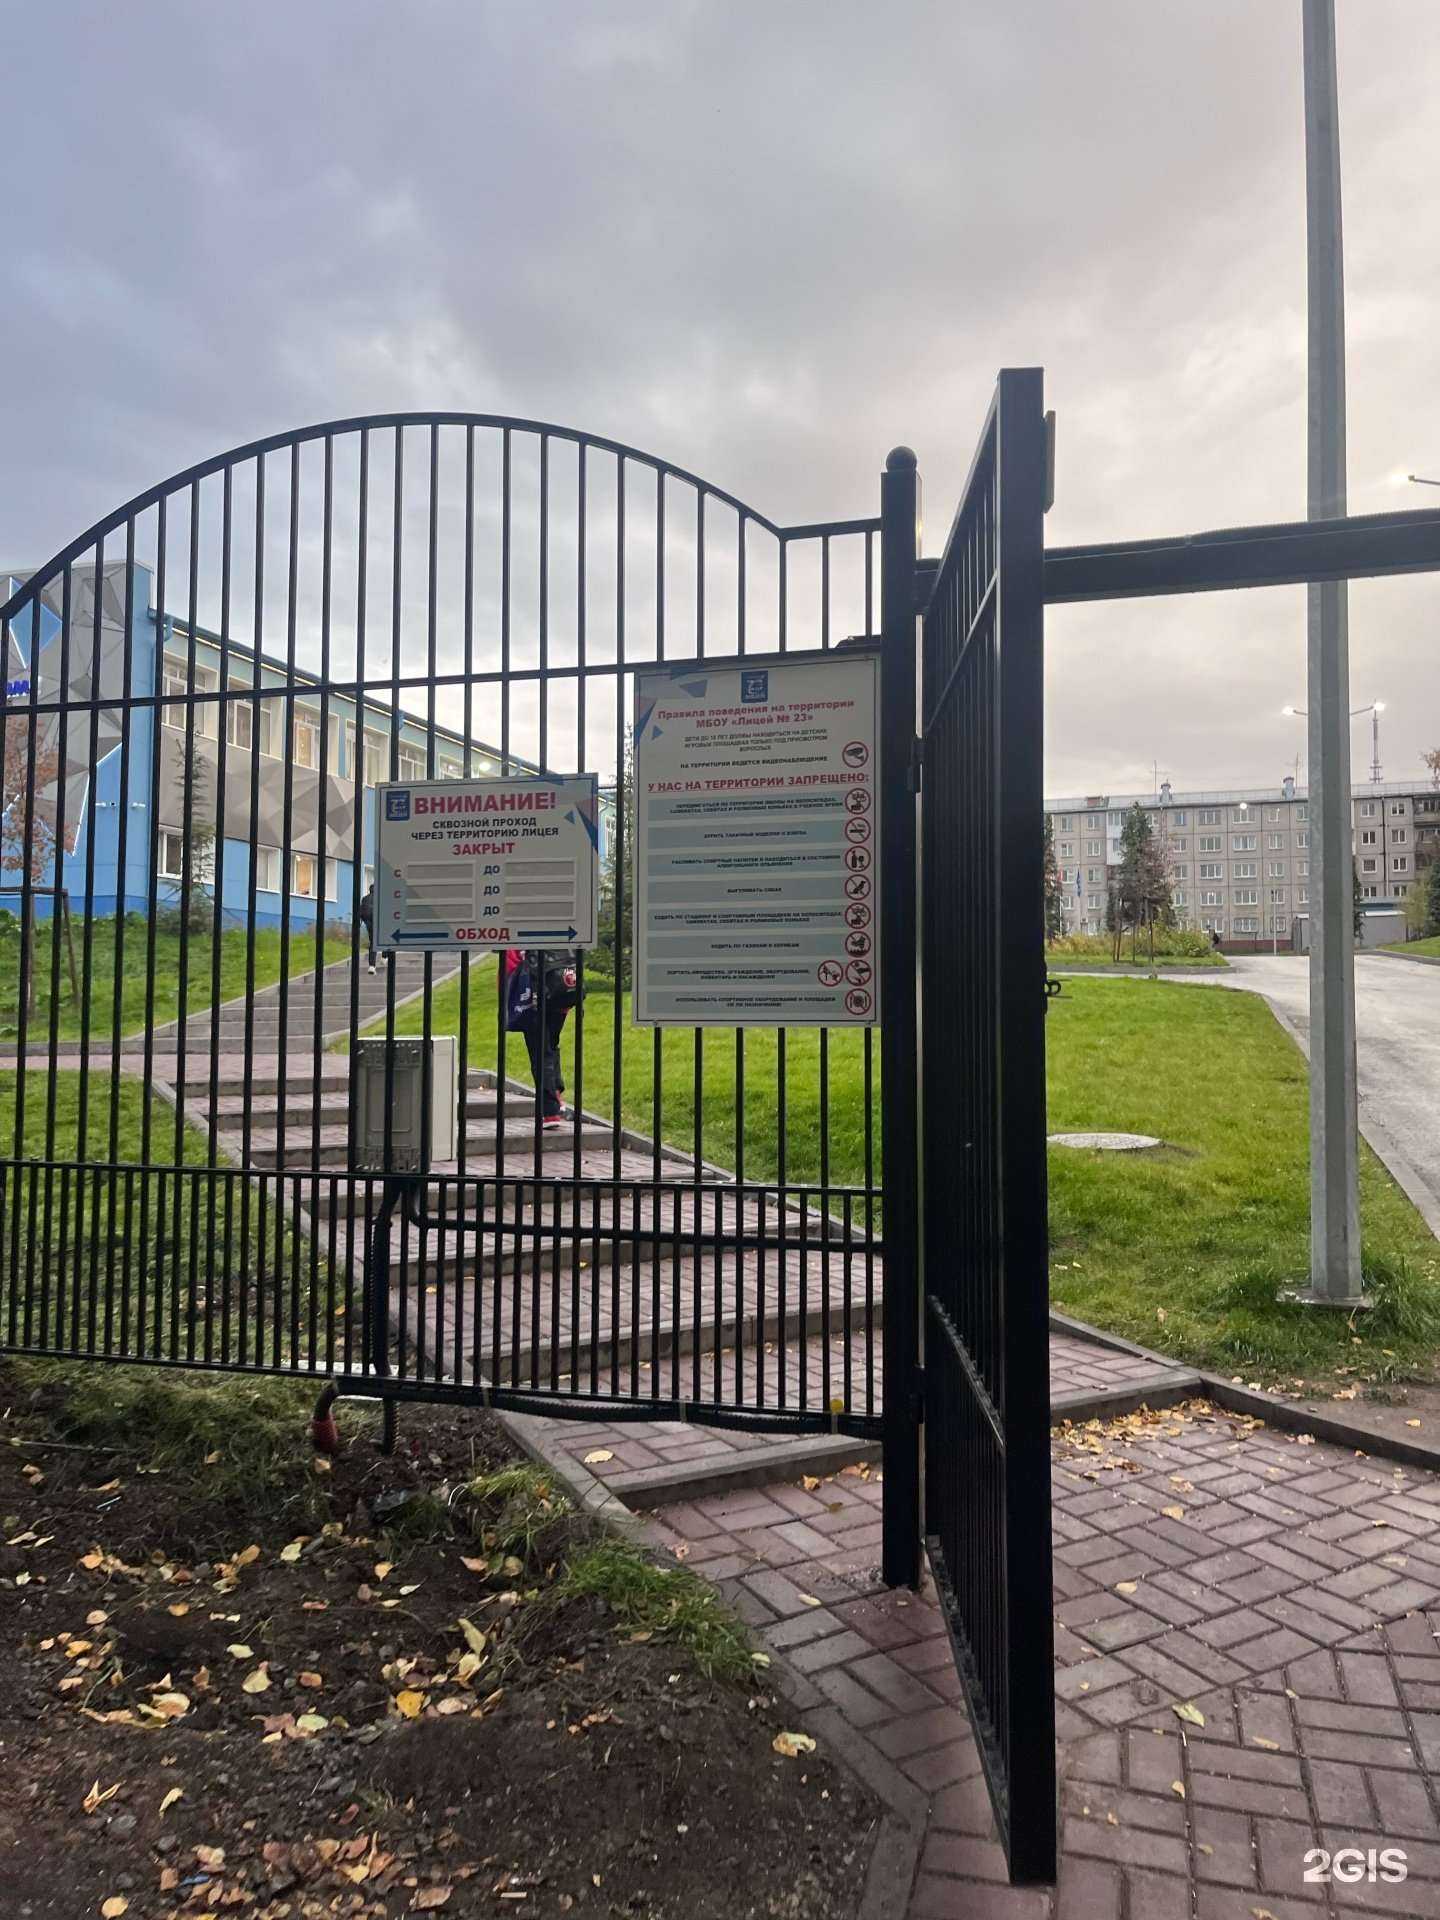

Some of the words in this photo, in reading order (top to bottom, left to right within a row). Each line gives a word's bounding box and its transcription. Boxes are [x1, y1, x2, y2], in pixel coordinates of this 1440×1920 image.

[657, 709, 705, 719] Правила
[708, 705, 768, 717] поведения
[771, 704, 785, 712] на
[788, 700, 854, 712] территории
[696, 718, 728, 728] МБОУ
[648, 782, 655, 792] У
[658, 781, 682, 791] НАС
[686, 780, 702, 790] НА
[704, 776, 785, 789] ТЕРРИТОРИИ
[788, 772, 870, 786] ЗАПРЕЩЕНО:
[414, 791, 557, 815] ВНИМАНИЕ!
[433, 817, 490, 829] СКВОЗНОЙ
[492, 817, 537, 828] ПРОХОД
[411, 830, 444, 841] ЧЕРЕЗ
[447, 828, 519, 840] ТЕРРИТОРИЮ
[521, 827, 559, 838] ЛИЦЕЯ
[452, 842, 515, 856] ЗАКРЫТ
[455, 927, 511, 941] ОБХОД
